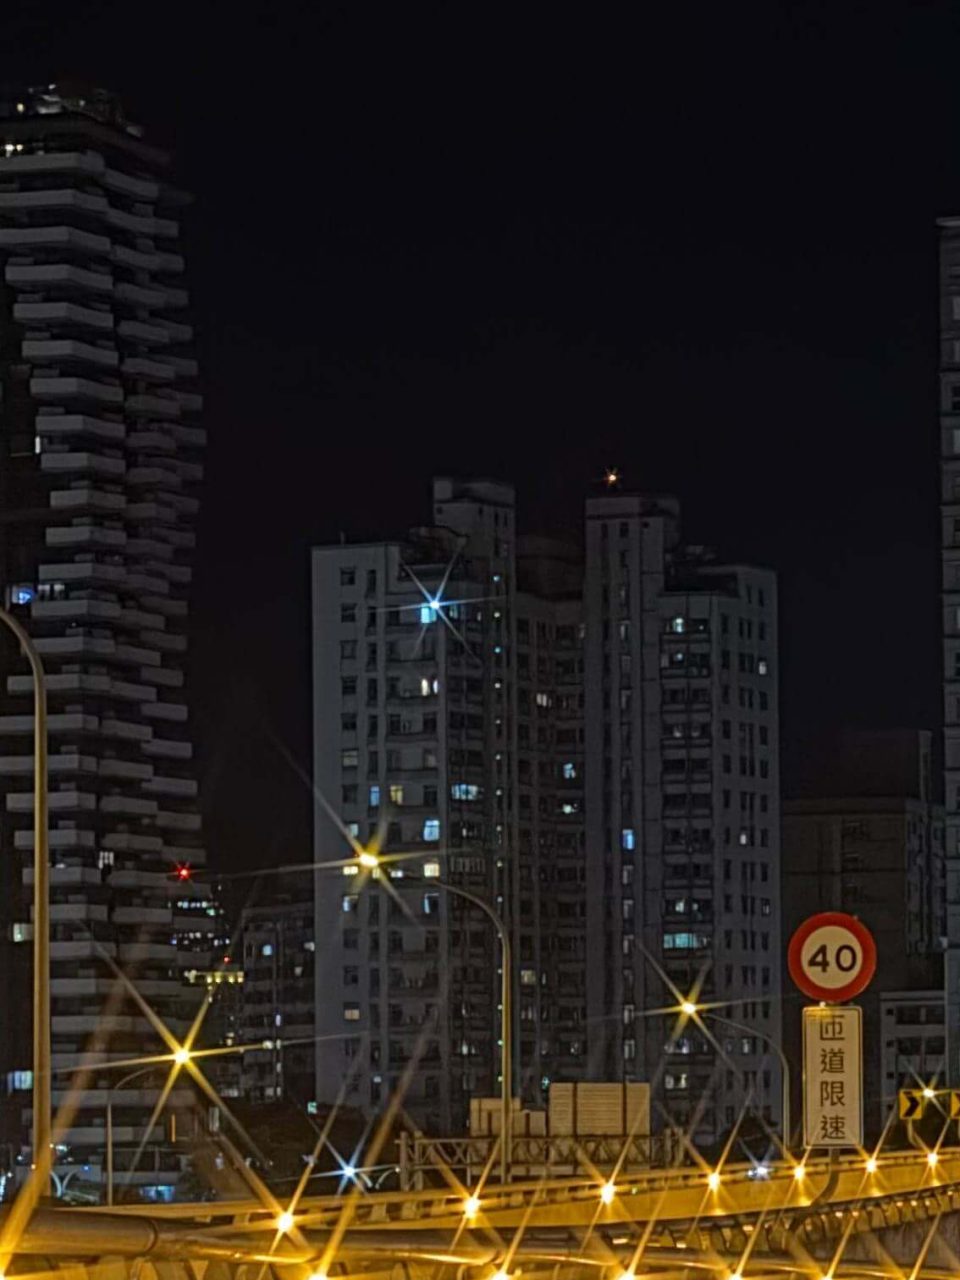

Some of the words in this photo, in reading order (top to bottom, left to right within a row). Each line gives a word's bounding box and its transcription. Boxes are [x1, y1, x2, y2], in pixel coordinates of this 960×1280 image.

[808, 944, 857, 973] 40
[820, 1014, 846, 1140] 匝道限速
